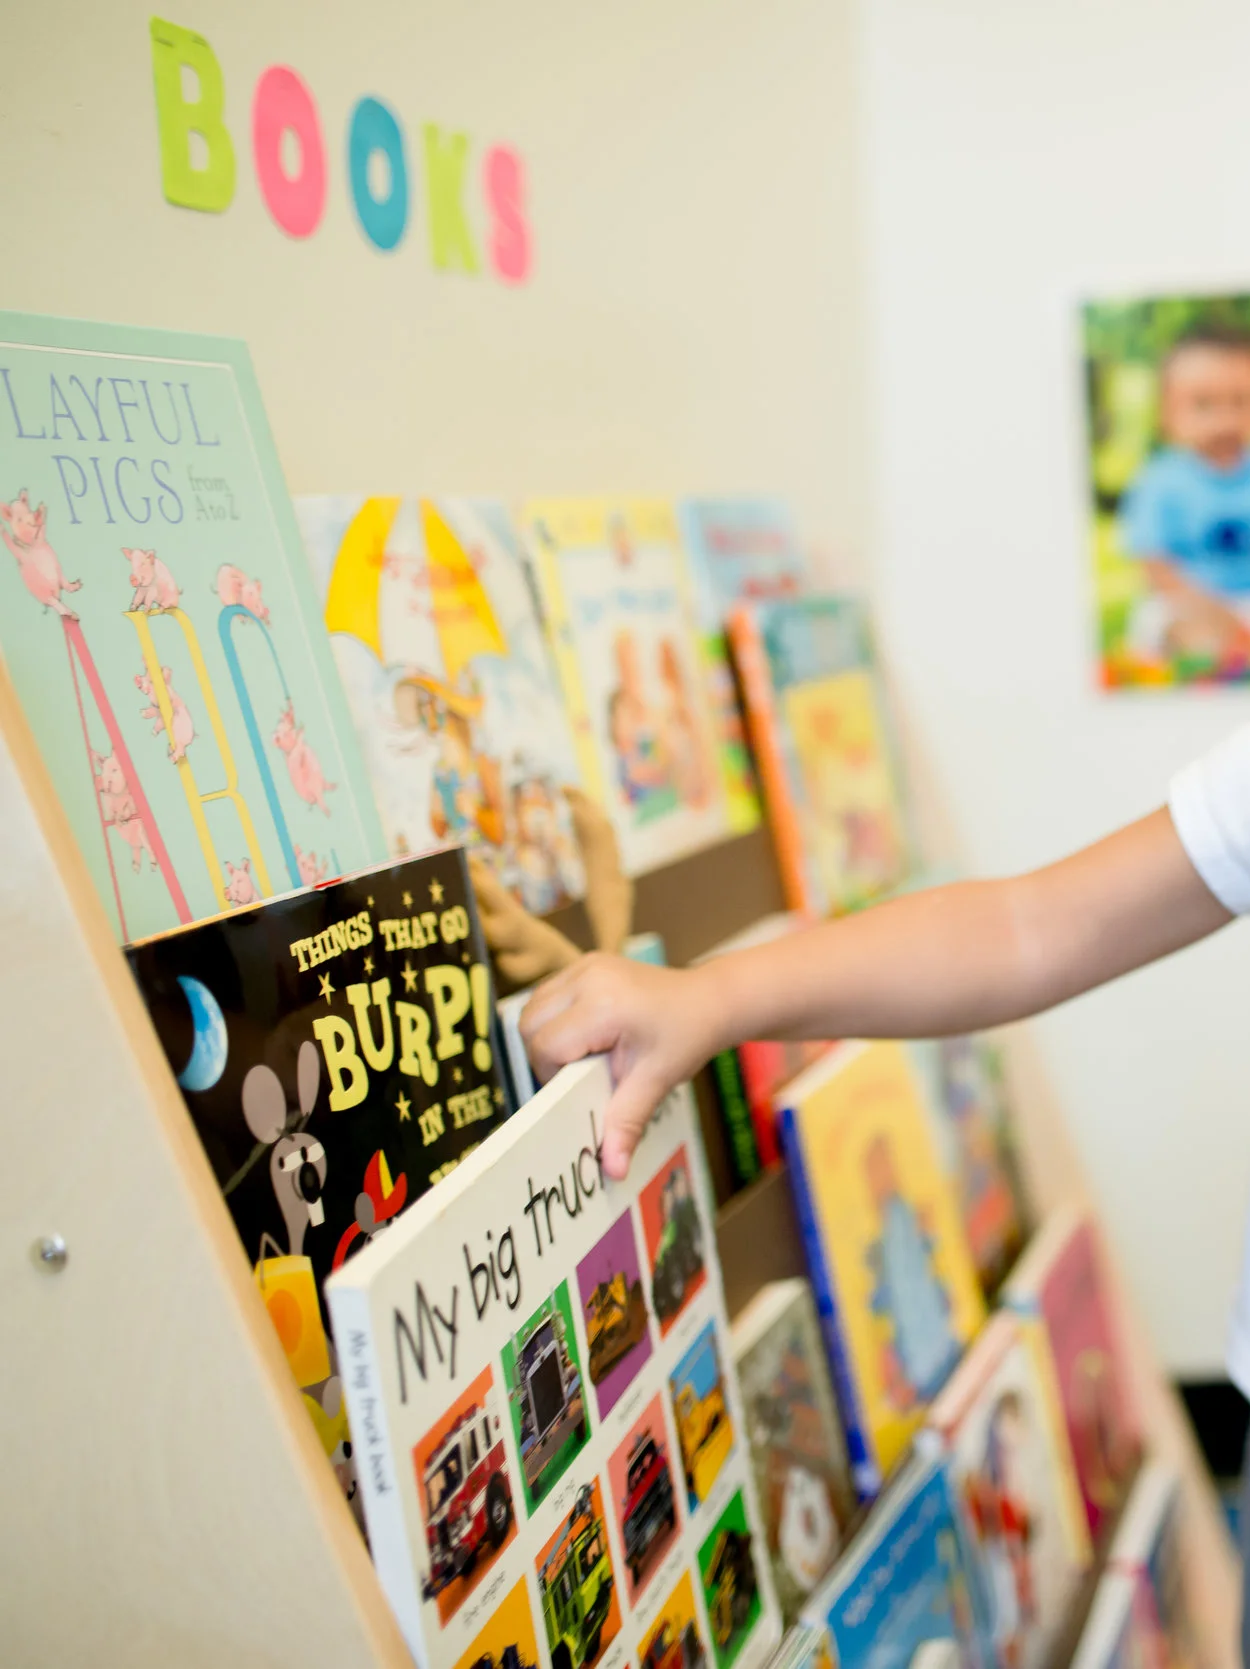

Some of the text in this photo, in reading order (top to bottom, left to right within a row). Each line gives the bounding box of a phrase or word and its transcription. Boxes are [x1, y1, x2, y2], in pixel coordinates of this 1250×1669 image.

[149, 15, 534, 285] BOOKS
[0, 367, 221, 447] LAYFUL
[51, 454, 231, 525] PIGS from
[289, 905, 470, 973] THINGS THAT GO
[312, 963, 493, 1112] BURP!
[418, 1084, 494, 1147] IN THE
[394, 1281, 459, 1405] My
[463, 1225, 521, 1321] big
